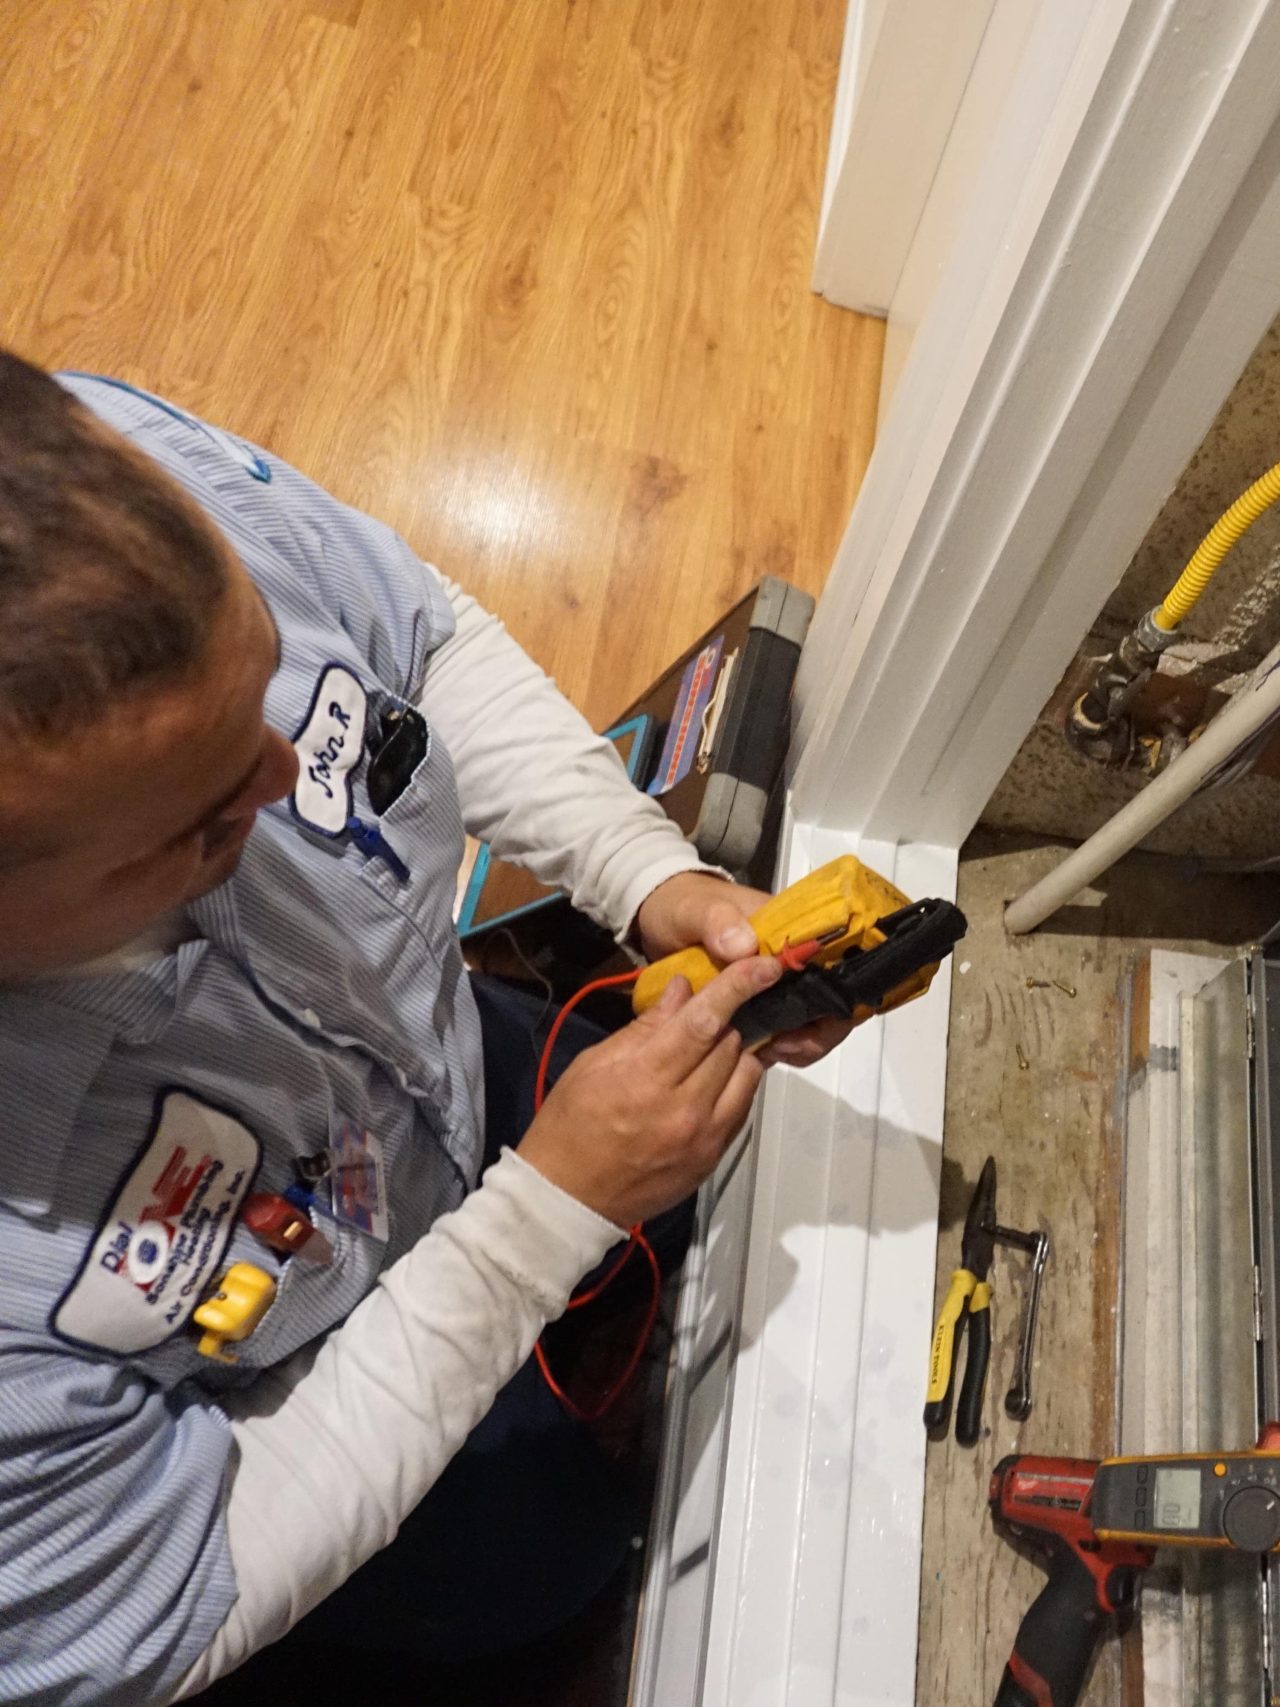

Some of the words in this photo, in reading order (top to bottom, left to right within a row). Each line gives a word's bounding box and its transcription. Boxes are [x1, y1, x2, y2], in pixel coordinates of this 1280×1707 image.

[308, 735, 344, 799] John
[329, 701, 351, 729] R
[100, 1222, 132, 1274] Dial
[166, 1302, 183, 1324] Air
